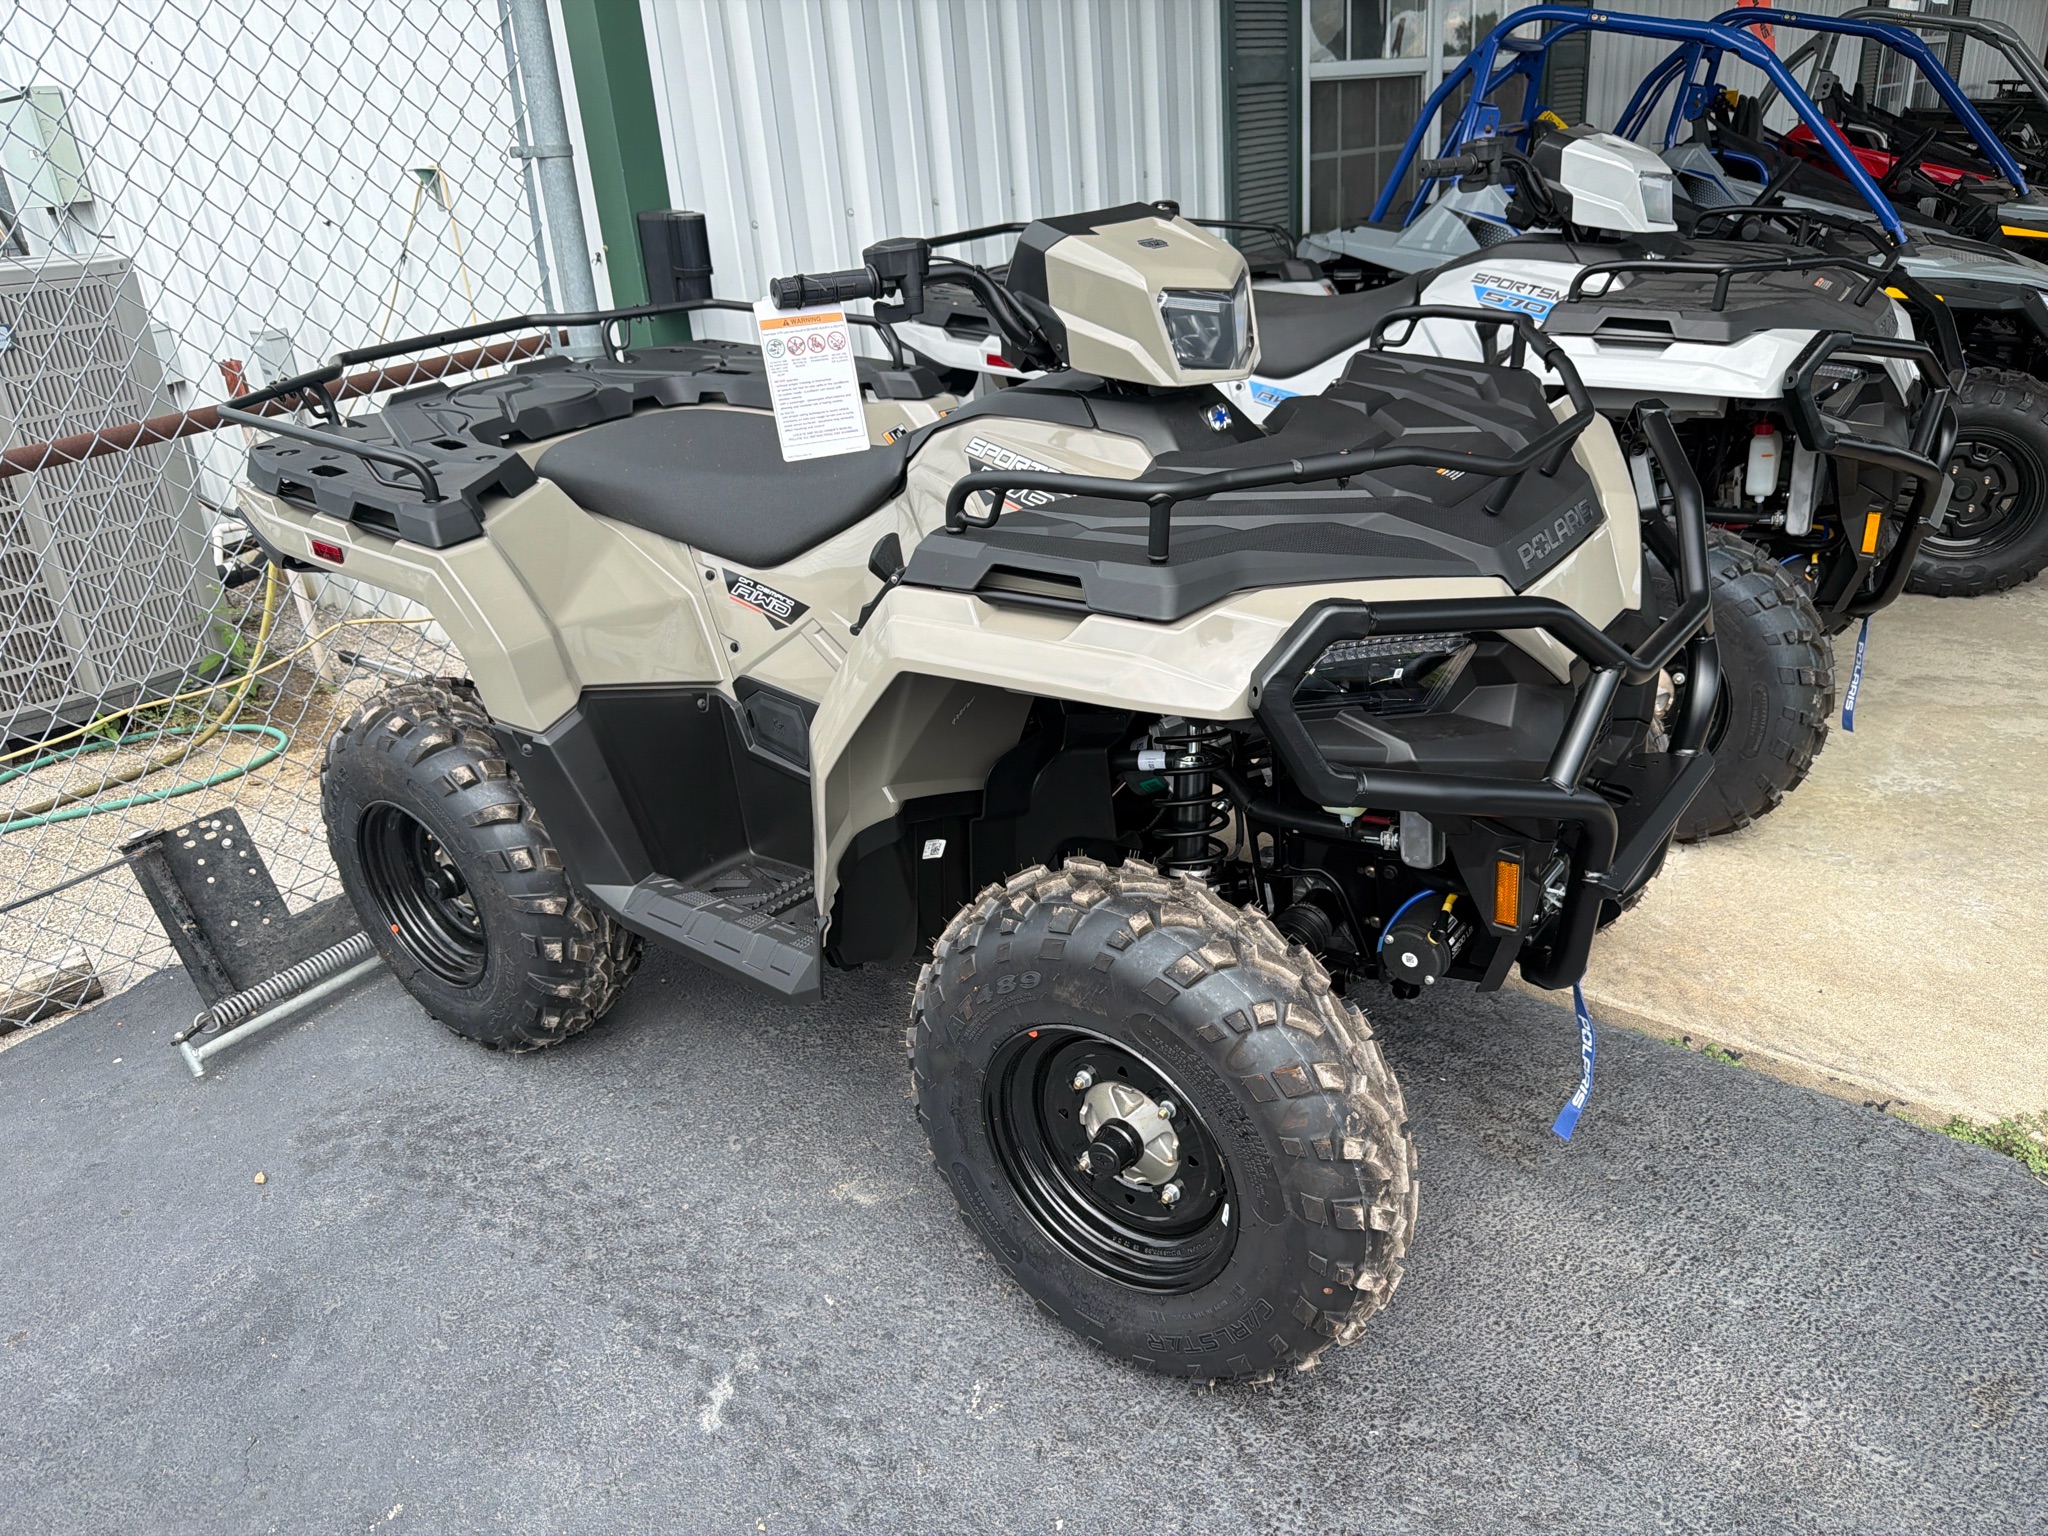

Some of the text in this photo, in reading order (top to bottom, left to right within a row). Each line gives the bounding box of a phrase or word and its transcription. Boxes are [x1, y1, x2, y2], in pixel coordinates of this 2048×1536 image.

[791, 316, 821, 325] WARNING
[1482, 291, 1548, 314] 570
[1517, 499, 1593, 570] POLARIS
[731, 582, 791, 617] AWD
[1845, 641, 1864, 711] POLARIS
[1571, 1014, 1593, 1109] POLARIS
[1145, 1297, 1275, 1354] CARLSTAR
